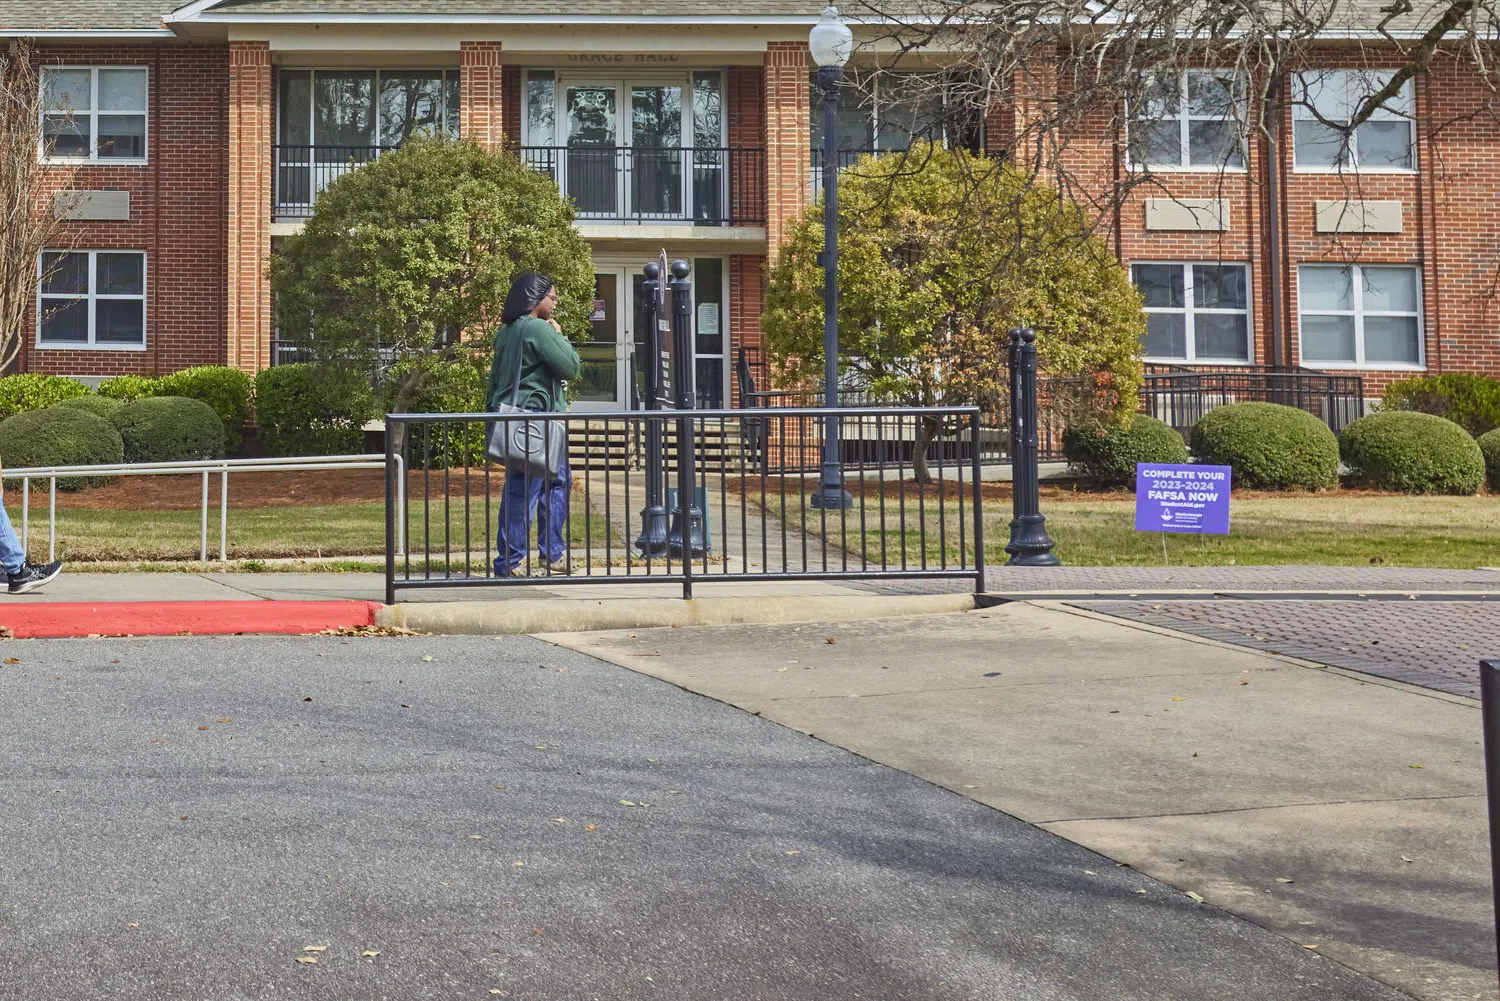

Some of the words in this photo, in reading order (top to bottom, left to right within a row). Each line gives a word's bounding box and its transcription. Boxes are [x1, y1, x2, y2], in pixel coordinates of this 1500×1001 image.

[1143, 470, 1195, 479] COMPLETE
[1197, 471, 1225, 480] YOUR
[1153, 480, 1214, 490] 2023-2024
[1148, 490, 1186, 501] FAFSA
[1188, 492, 1219, 502] NOW
